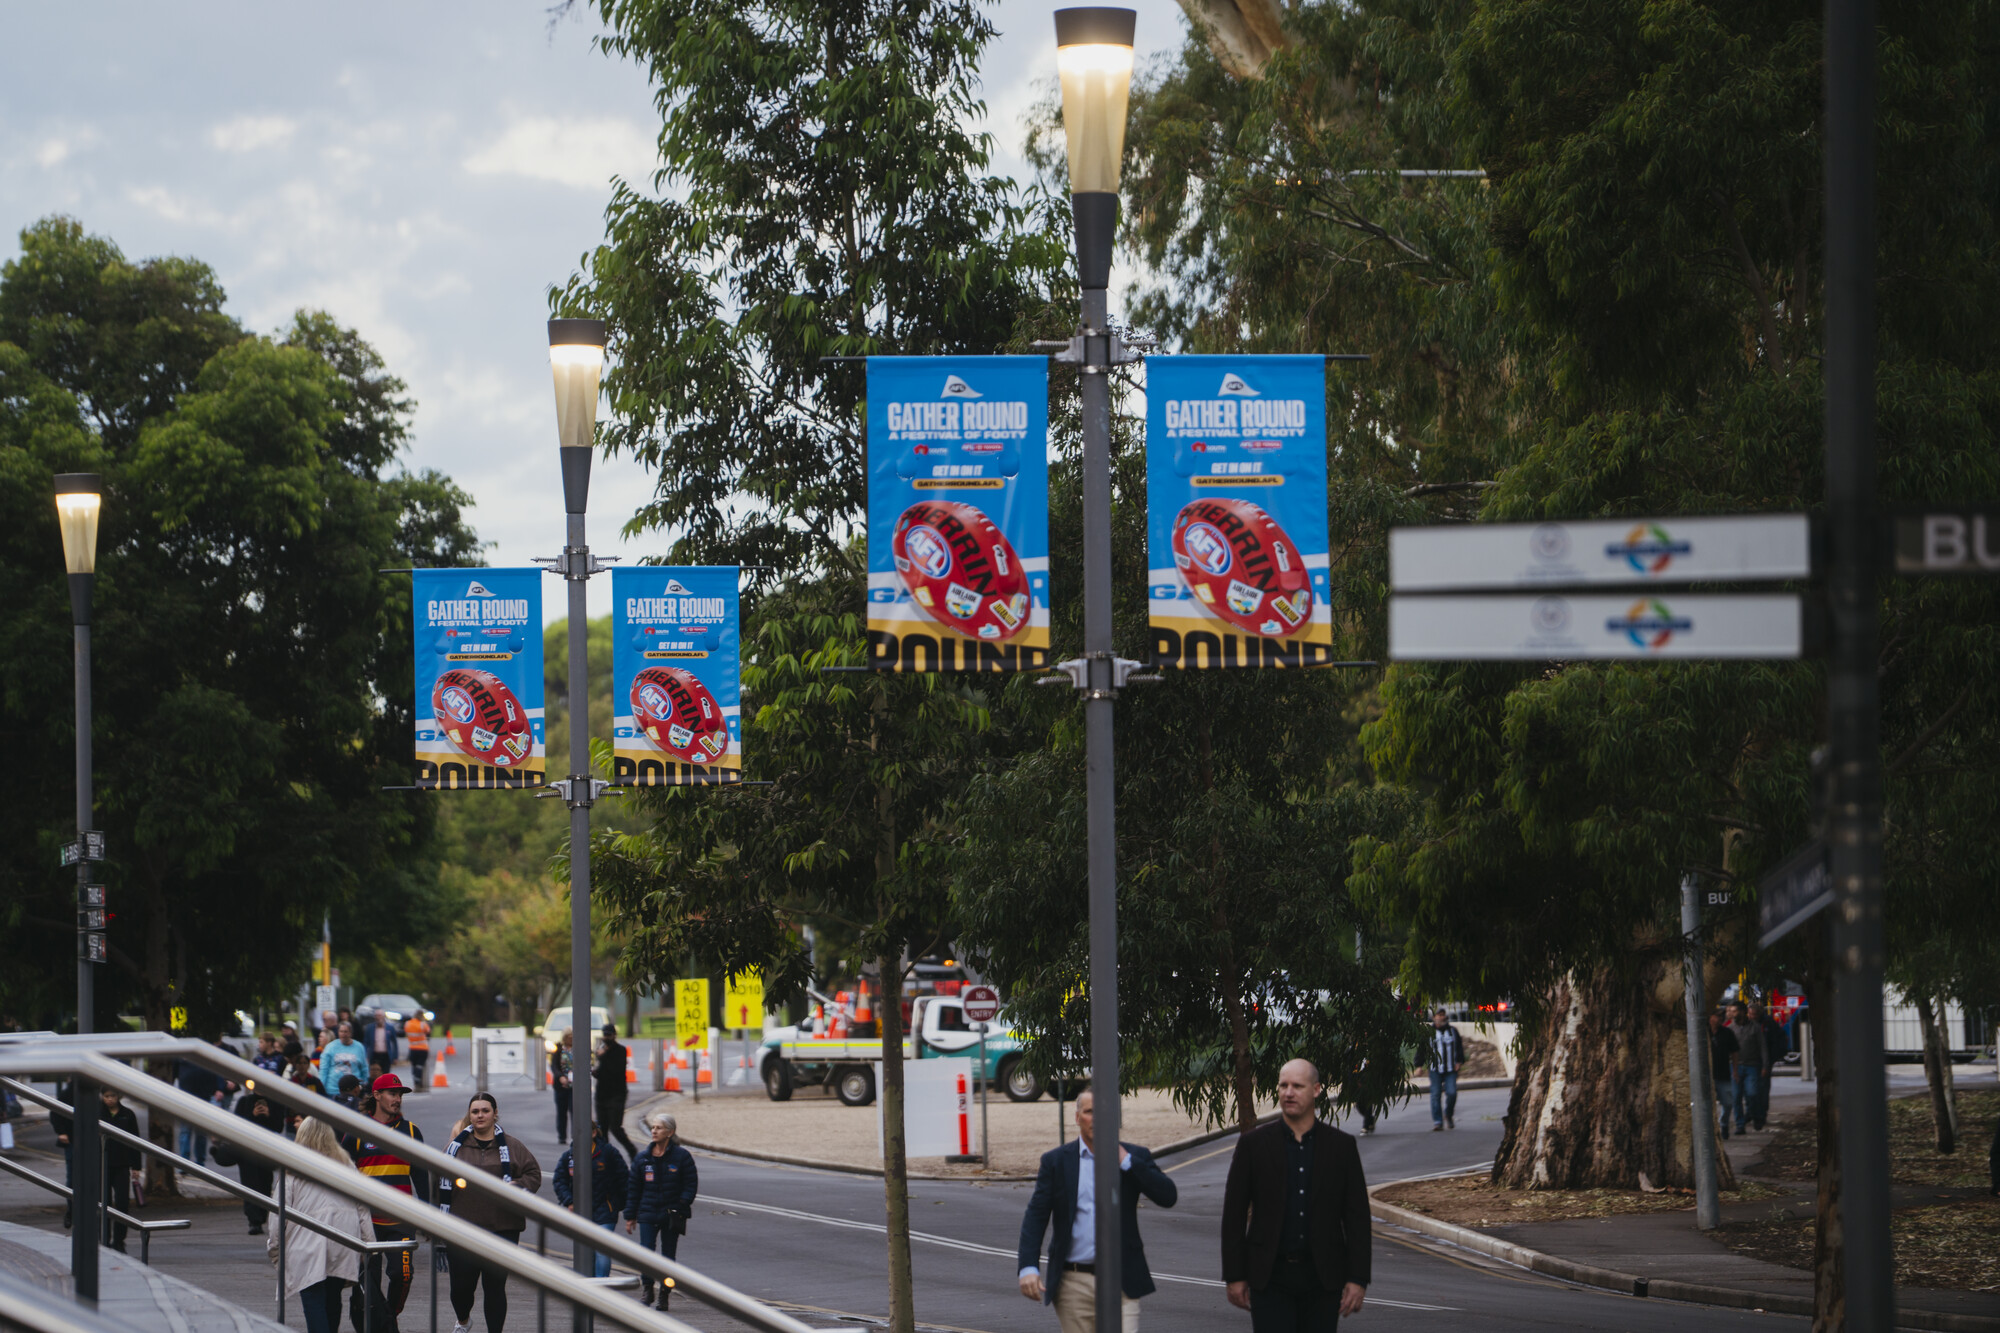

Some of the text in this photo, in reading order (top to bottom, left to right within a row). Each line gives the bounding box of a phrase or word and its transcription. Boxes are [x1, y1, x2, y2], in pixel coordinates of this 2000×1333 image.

[950, 384, 966, 392] AFL
[1227, 381, 1243, 390] AFL
[887, 402, 1028, 431] GATHER ROUND
[1165, 400, 1305, 428] GATHER ROUND
[888, 431, 1028, 440] A FESTIVAL OF FOOTY
[1166, 428, 1305, 438] A FESTIVAL OF FOOTY
[932, 465, 984, 477] GET IN ON IT
[1211, 462, 1263, 474] GET IN ON IT
[902, 505, 997, 597] SHERRIN
[906, 530, 946, 576] AFL
[1179, 502, 1279, 594] SHERRIN
[1184, 527, 1227, 574] AFL
[428, 599, 528, 620] GATHER ROUND
[627, 598, 724, 618] GATHER ROUND
[460, 644, 472, 652] GET
[867, 629, 1050, 672] ROUND
[1149, 626, 1332, 669] ROUND
[438, 672, 508, 736] SHERRIN
[442, 690, 470, 722] AFL
[636, 669, 704, 734] SHERRIN
[639, 687, 667, 719] AFL
[415, 759, 546, 789] ROUND
[613, 756, 742, 786] ROUND
[1708, 892, 1734, 905] BU
[682, 981, 700, 993] AO
[975, 991, 986, 1000] NO
[682, 995, 700, 1006] 1-8
[684, 1008, 702, 1019] AO
[970, 1009, 992, 1018] ENTRY
[677, 1021, 707, 1033] 11-14
